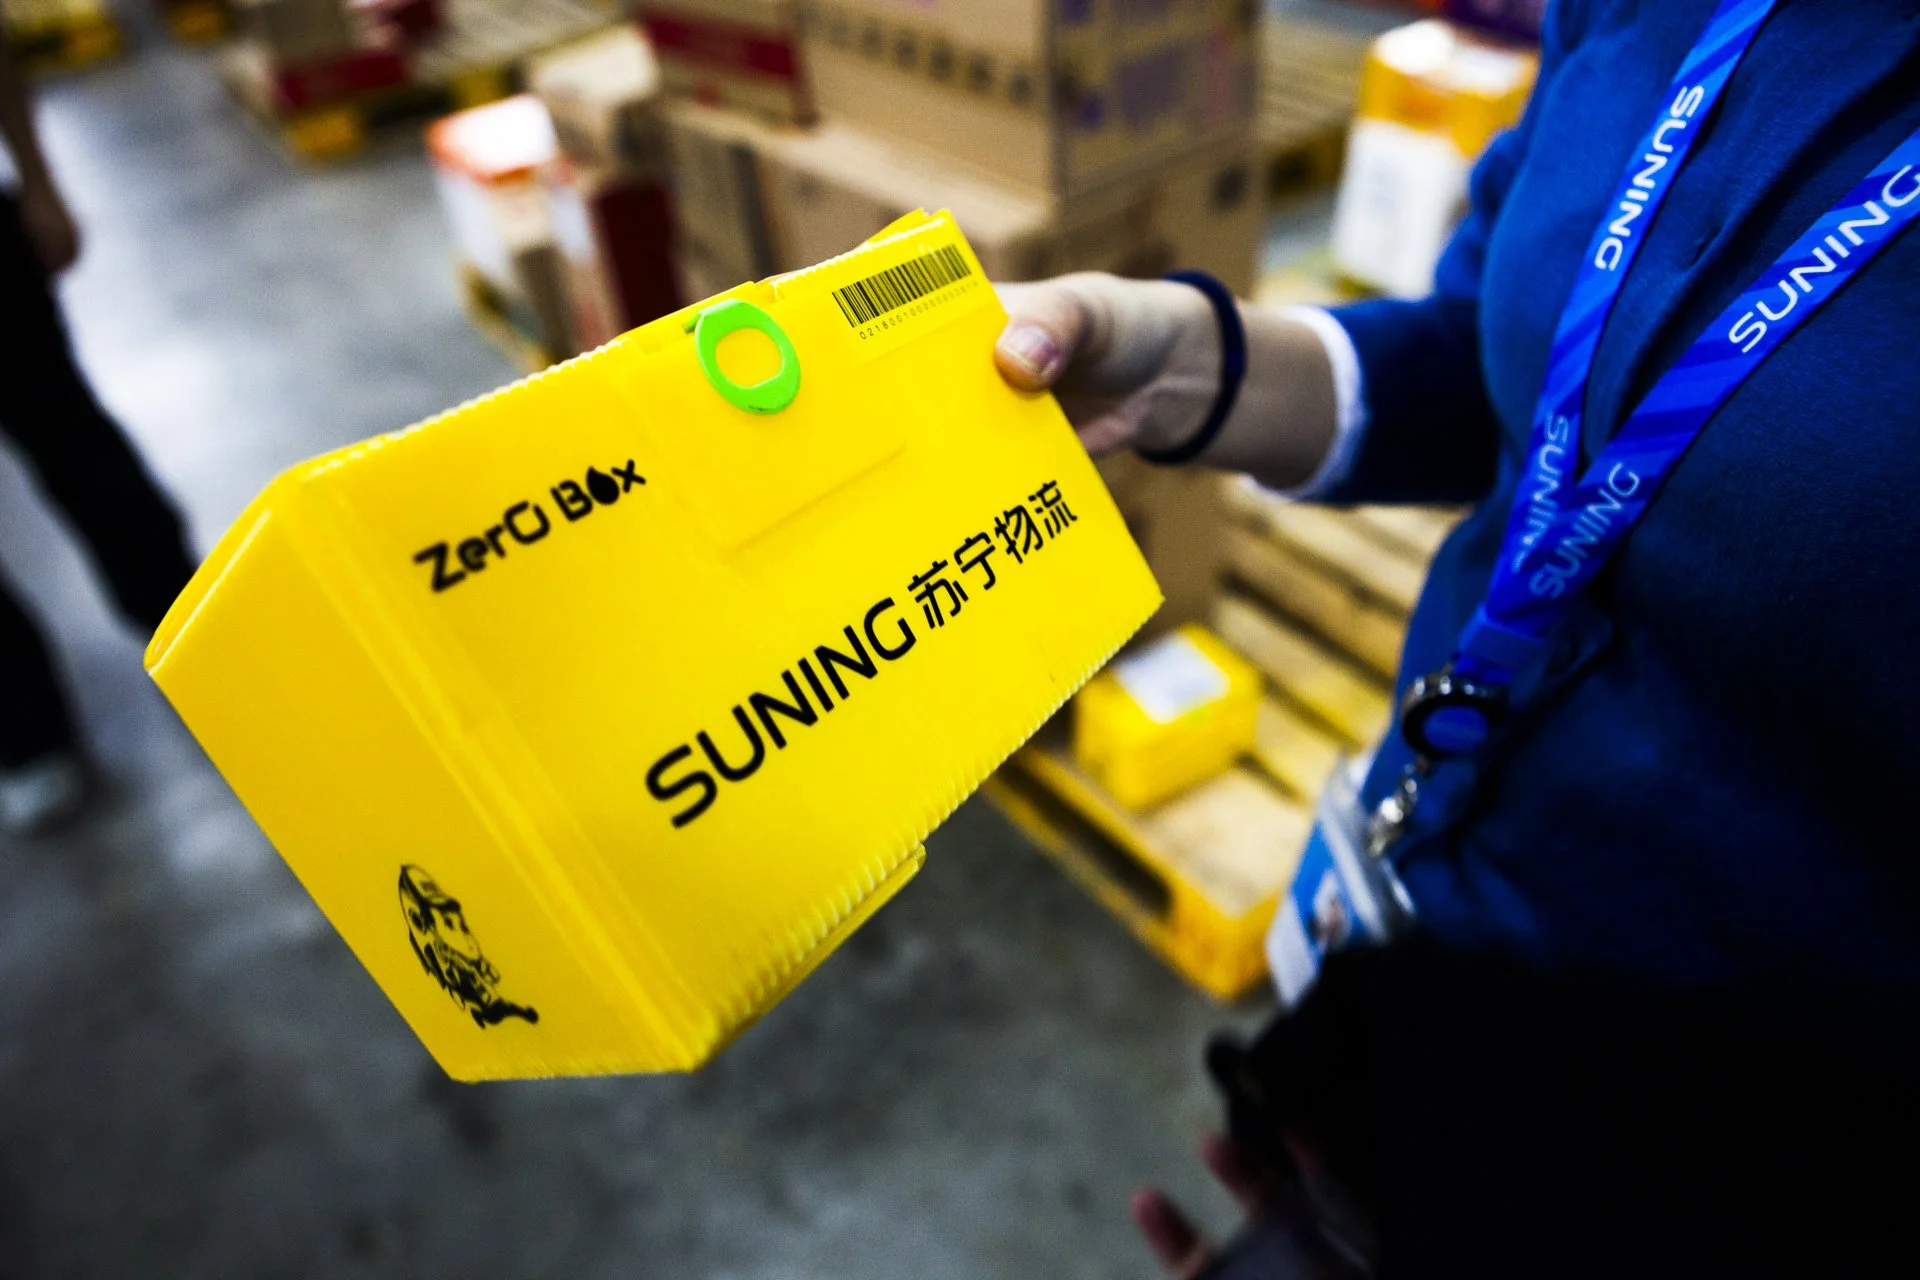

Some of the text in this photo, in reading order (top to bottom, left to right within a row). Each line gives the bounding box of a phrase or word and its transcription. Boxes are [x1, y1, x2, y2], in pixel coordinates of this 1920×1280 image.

[1594, 85, 1704, 271] SUNING
[1728, 164, 1920, 353] SUNING
[1529, 462, 1640, 599] SUNING
[645, 480, 1078, 829] SUNING 苏宁物流
